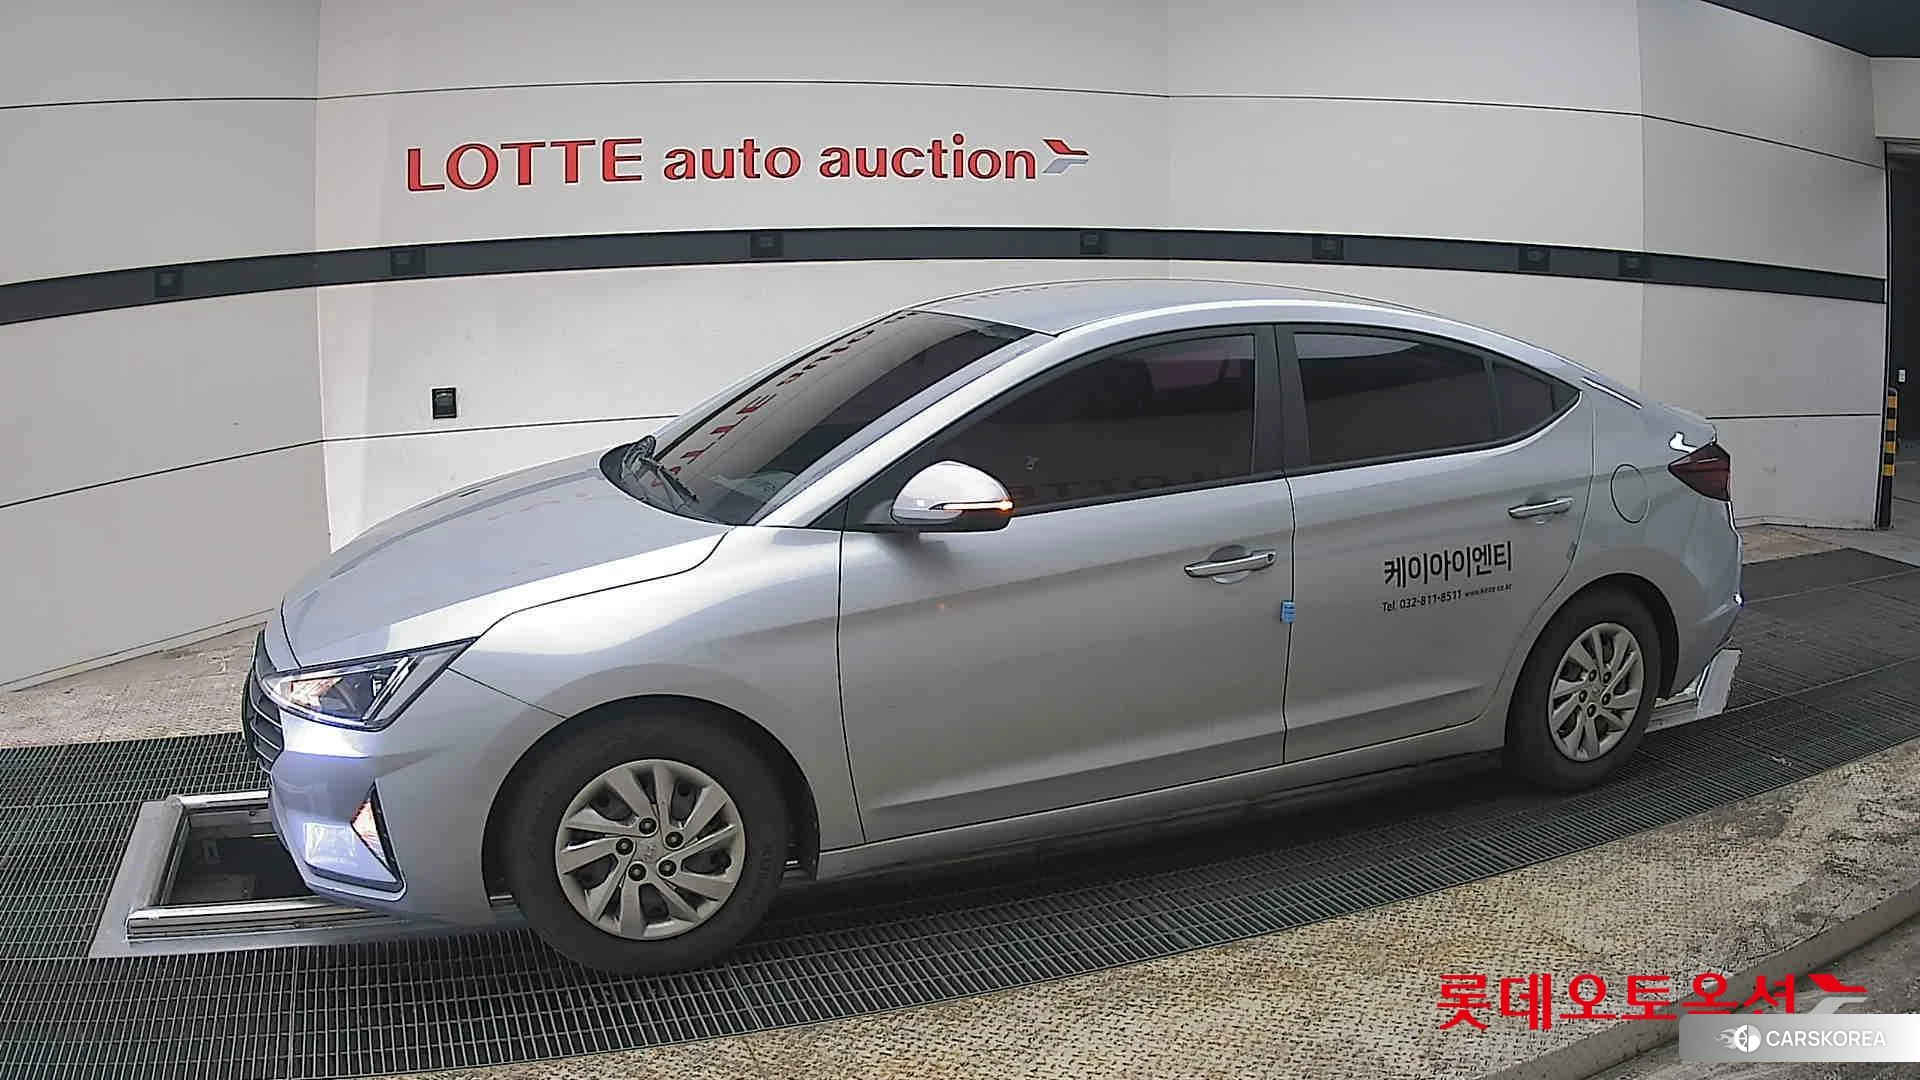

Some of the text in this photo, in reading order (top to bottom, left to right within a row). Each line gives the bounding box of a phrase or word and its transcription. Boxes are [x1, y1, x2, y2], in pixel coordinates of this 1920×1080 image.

[407, 134, 1037, 192] LOTTE auto auction
[1384, 541, 1512, 588] 케이아이엔티
